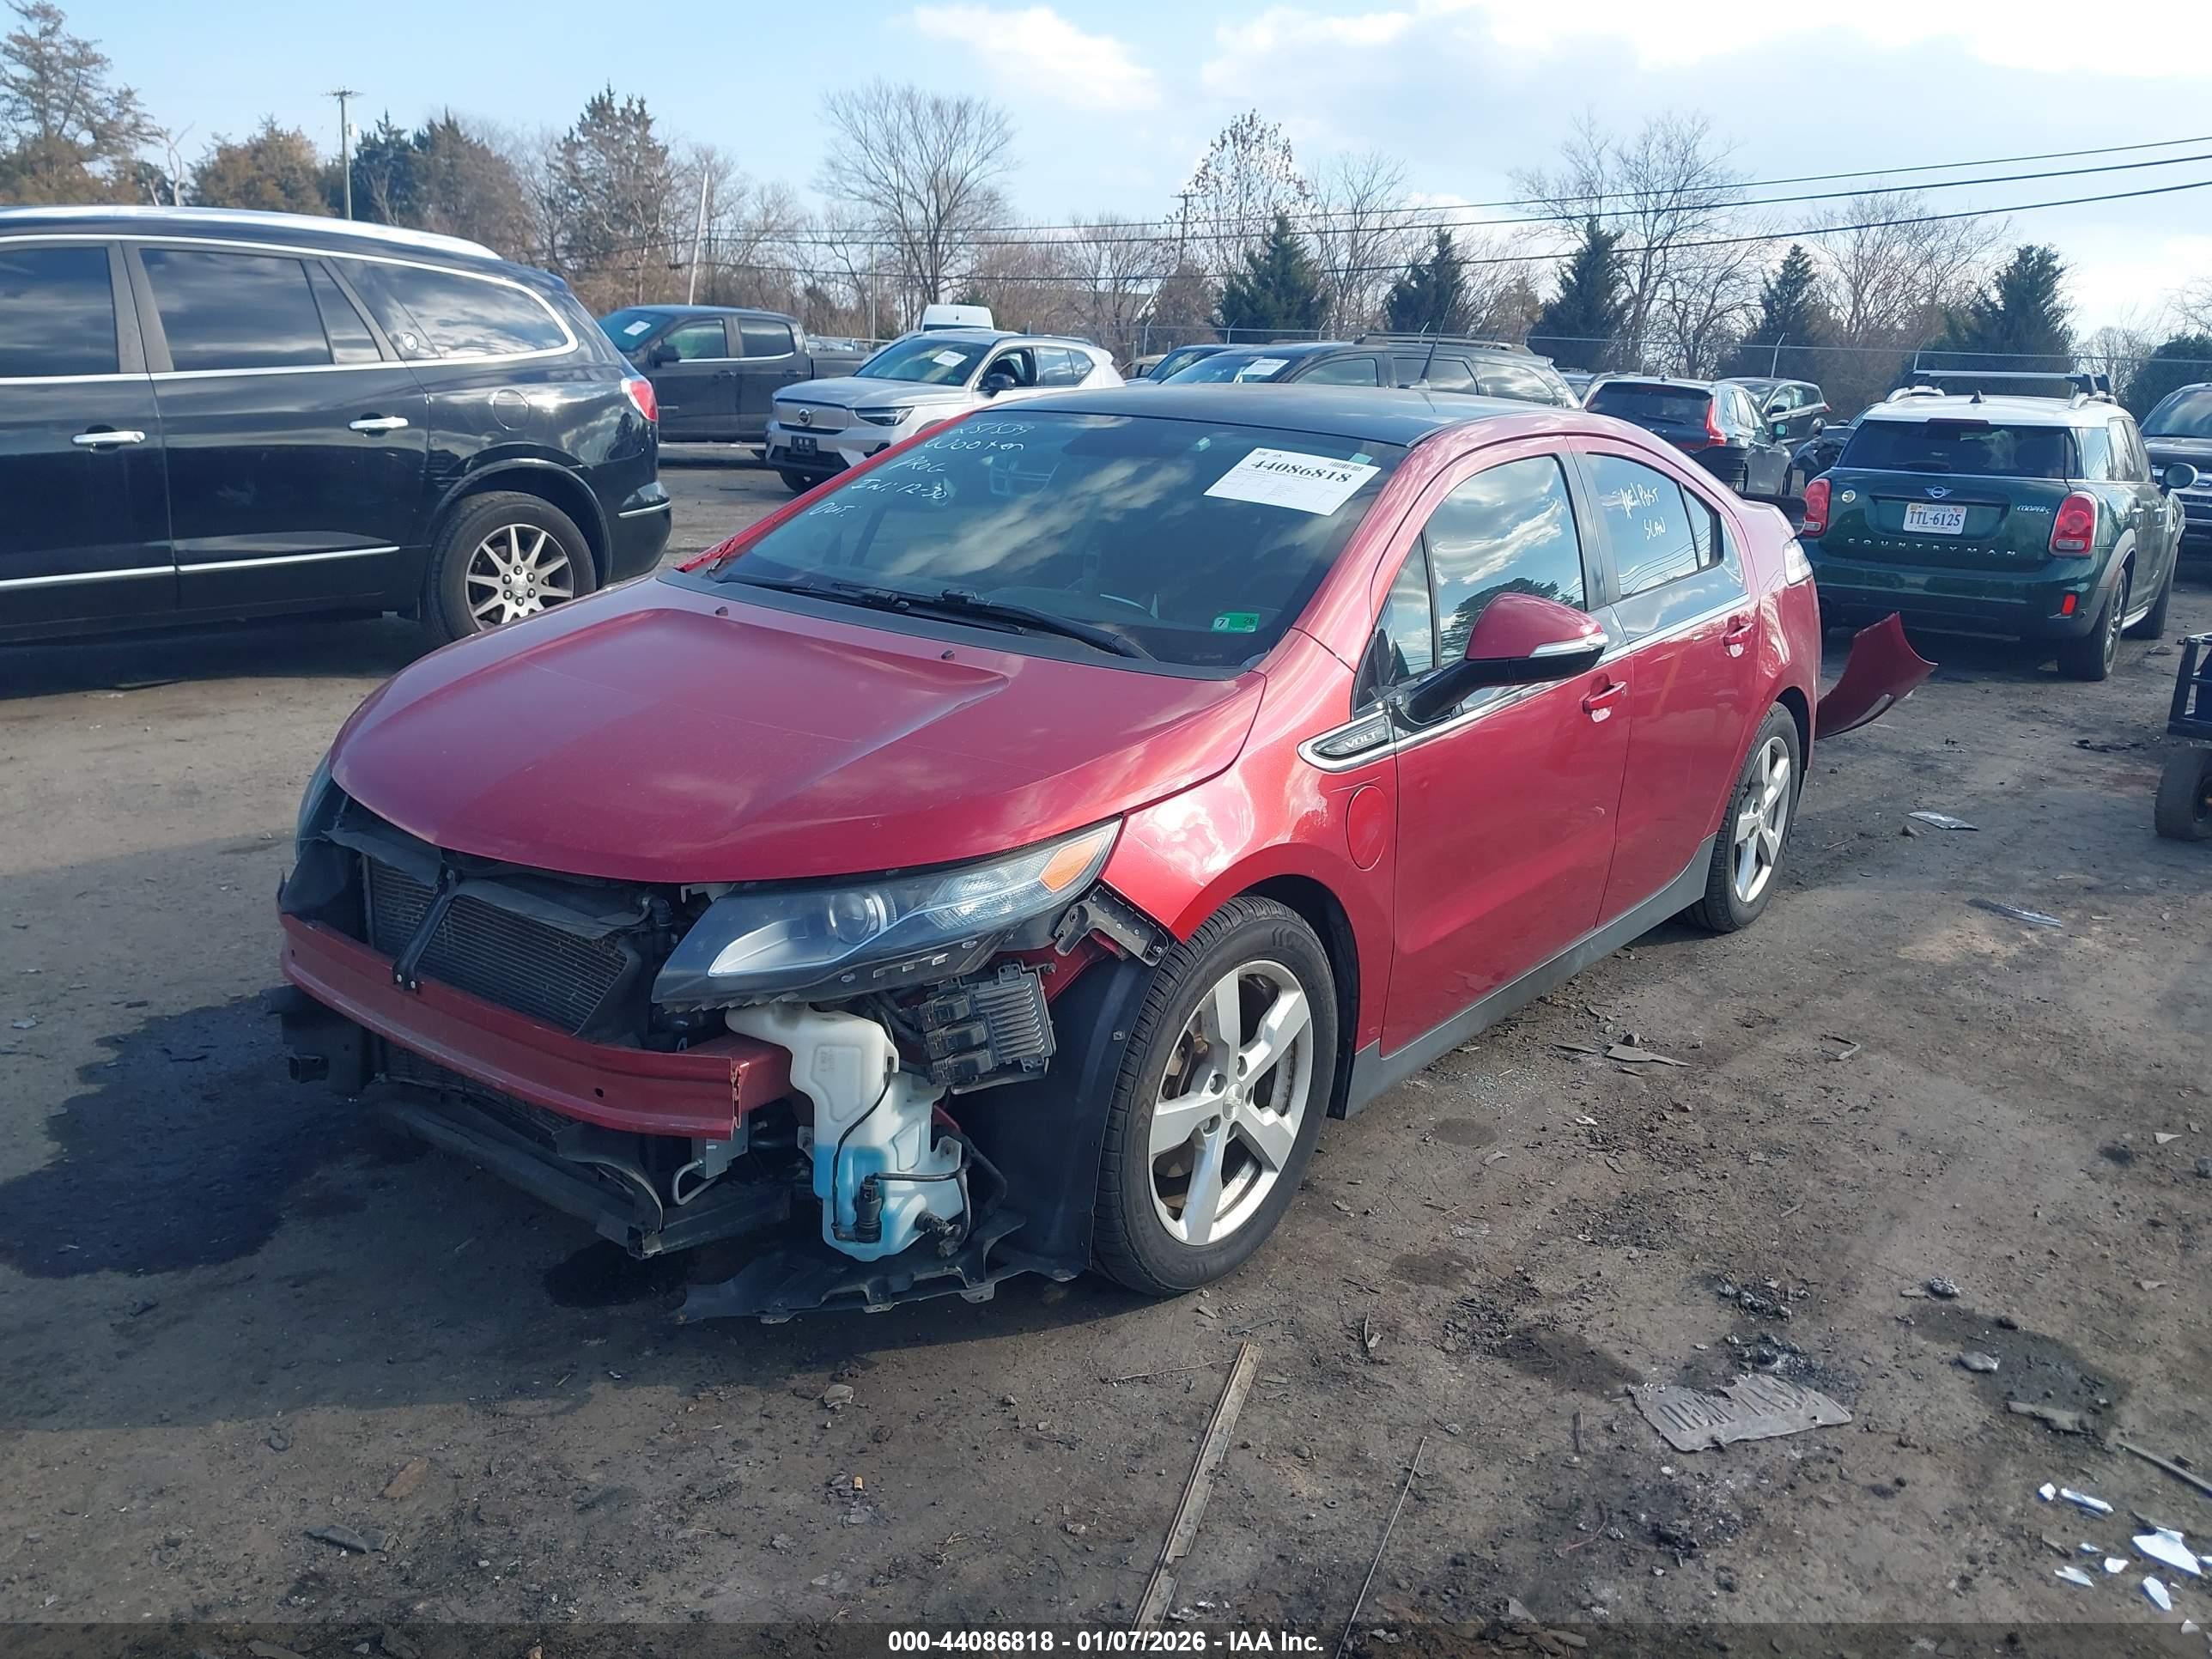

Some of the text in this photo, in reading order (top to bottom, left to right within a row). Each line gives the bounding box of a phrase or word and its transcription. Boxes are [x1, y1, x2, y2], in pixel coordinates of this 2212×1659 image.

[1250, 459, 1352, 483] 44086818
[1909, 511, 1961, 526] TTL-6125
[1848, 538, 2016, 556] COUNTRYMAN
[1218, 618, 1226, 628] 7
[1345, 731, 1377, 748] VOLT
